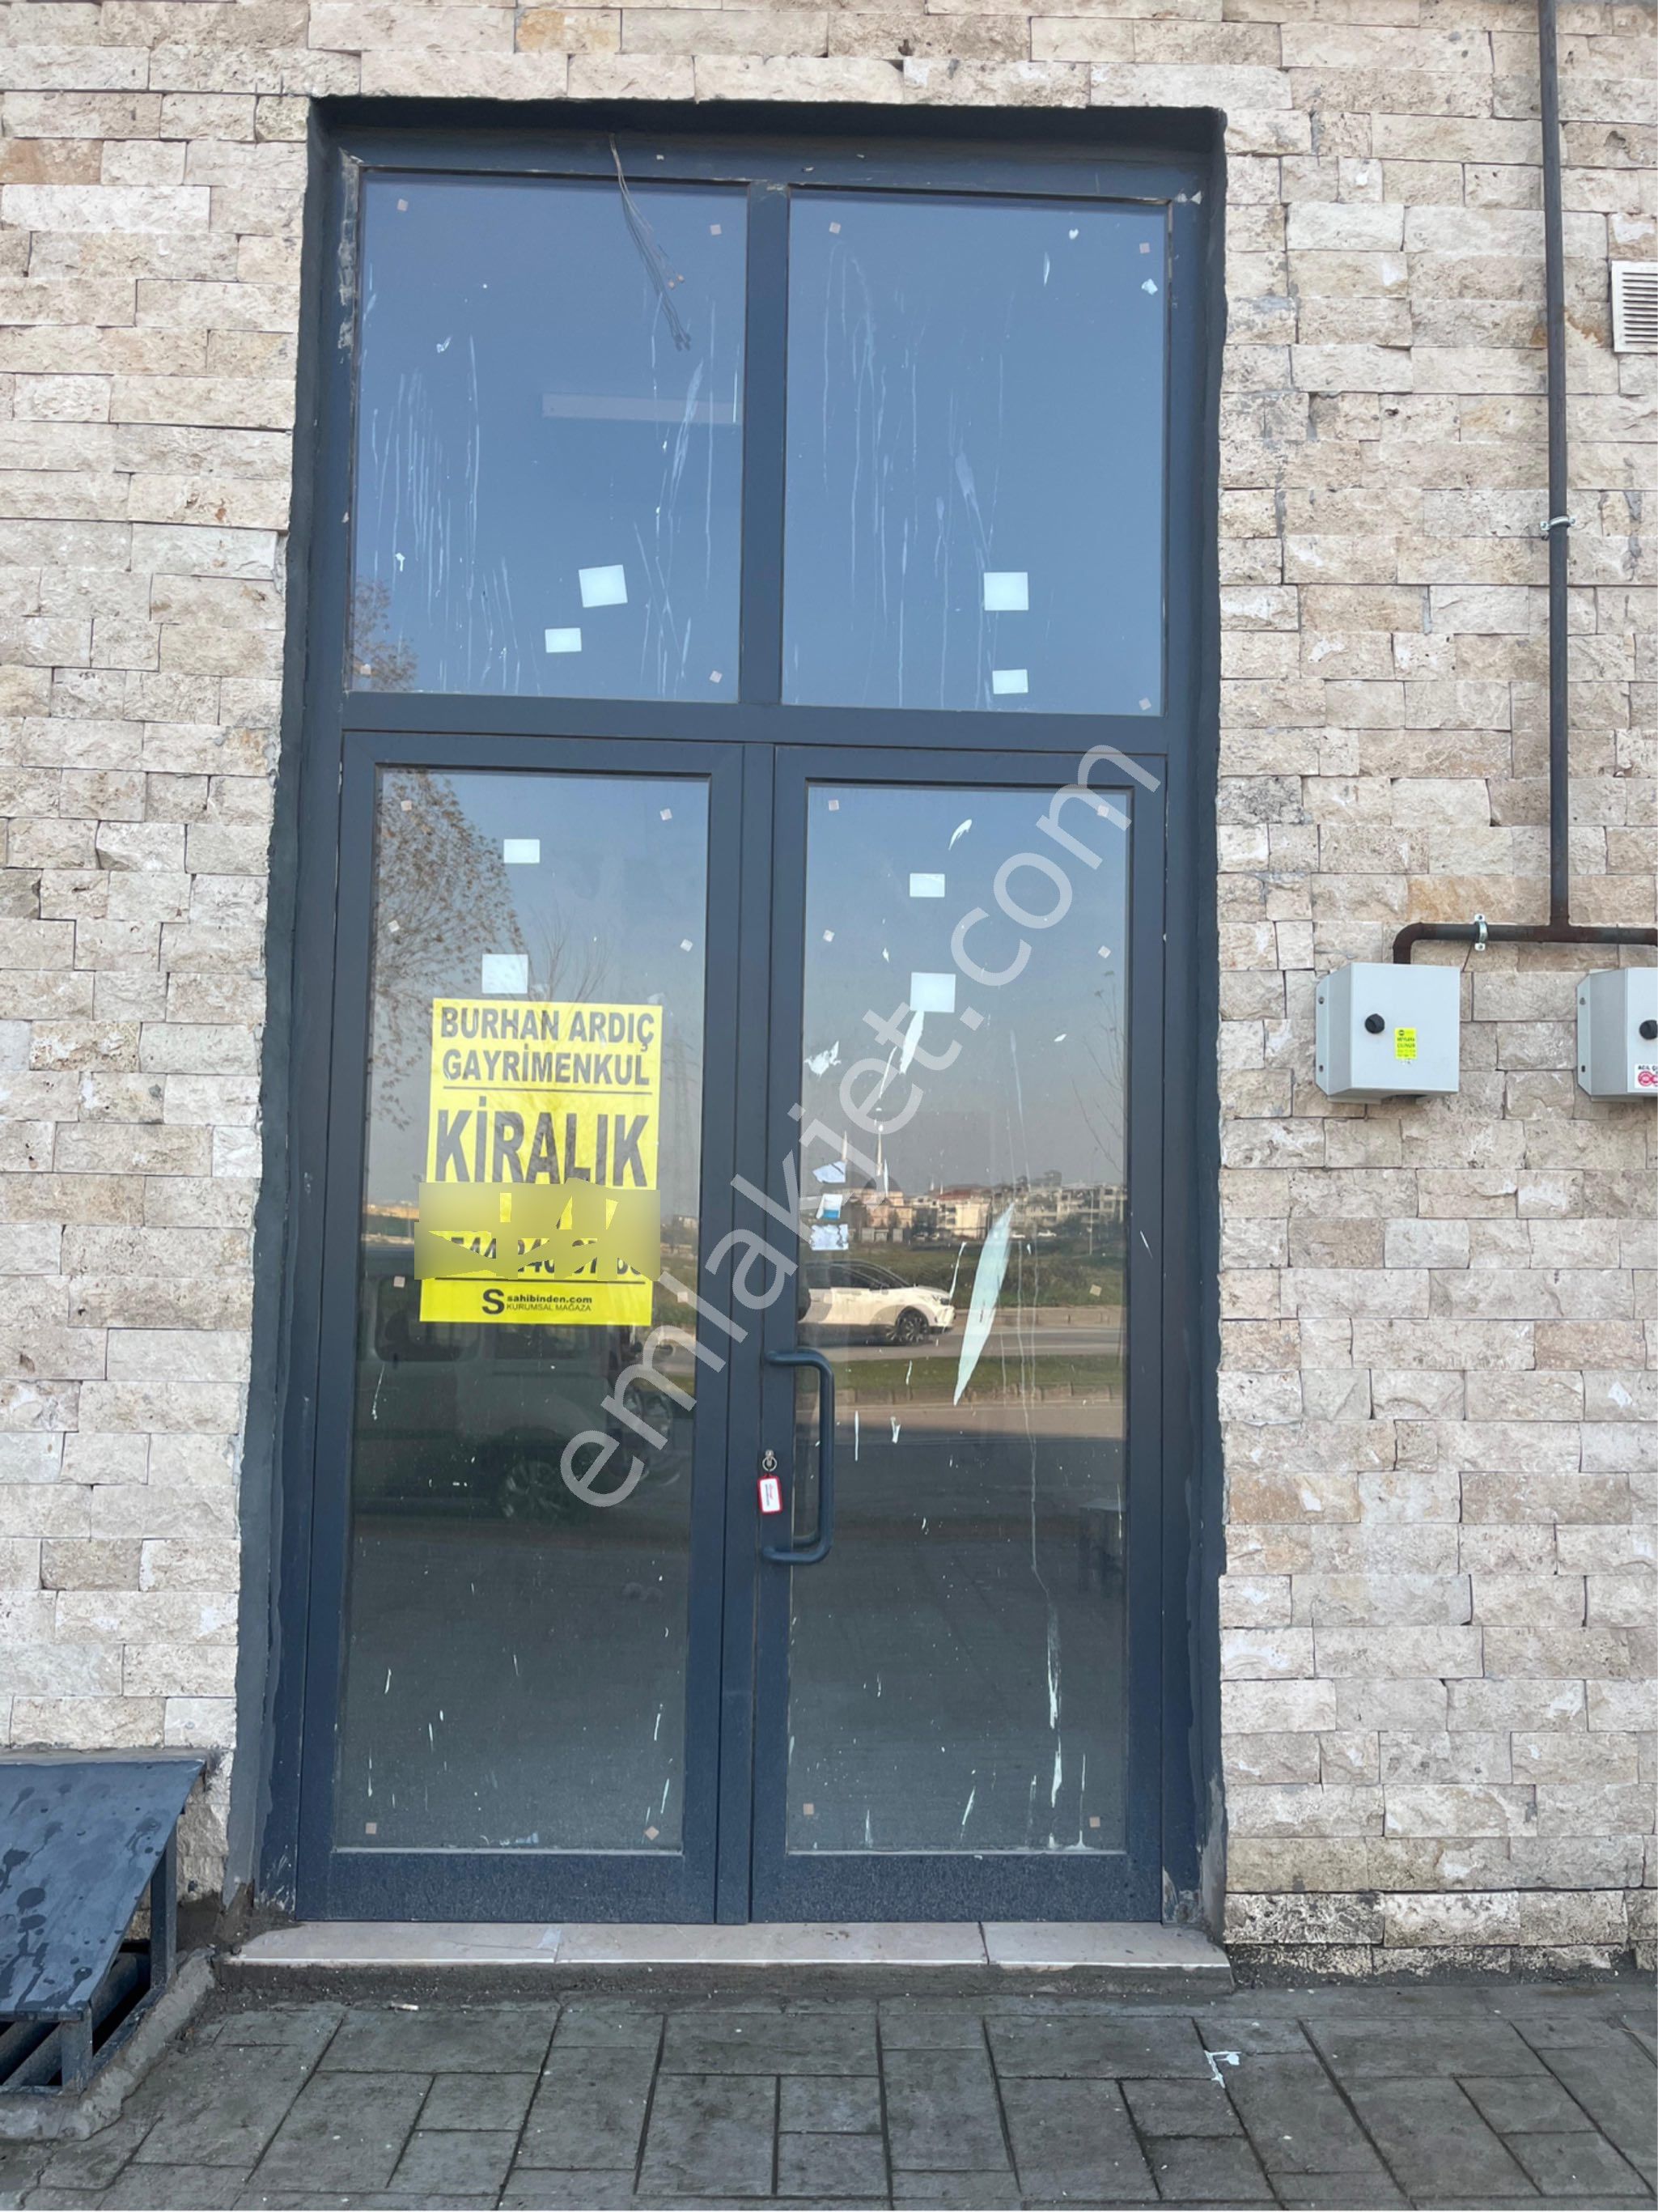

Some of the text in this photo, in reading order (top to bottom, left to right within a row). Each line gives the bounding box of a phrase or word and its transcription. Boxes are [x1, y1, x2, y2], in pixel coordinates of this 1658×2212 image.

[440, 1006, 655, 1051] BURHAN ARDIÇ
[443, 1042, 650, 1085] GAYRİMENKUL
[435, 1096, 649, 1187] KİRALIK
[507, 1294, 592, 1304] sahibinden.com
[507, 1302, 592, 1312] KURUMSAL MAĞAZA
